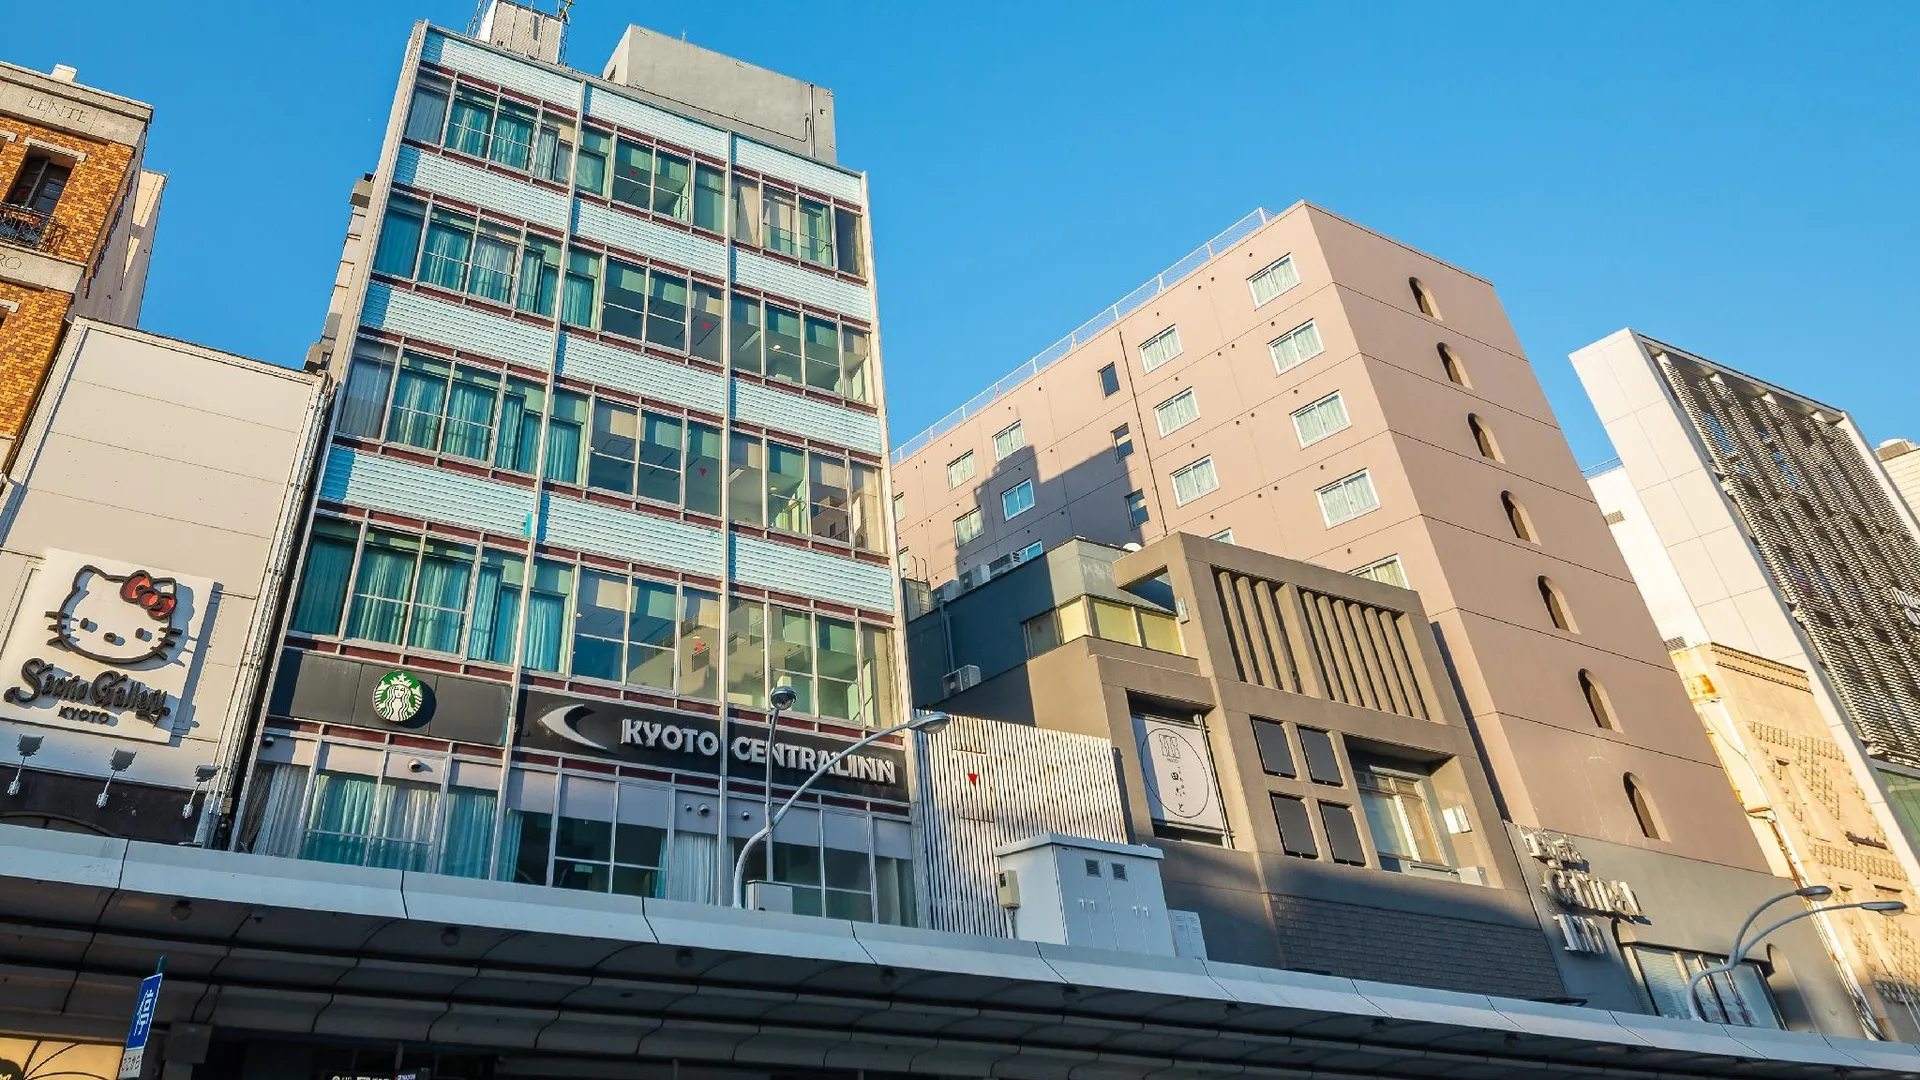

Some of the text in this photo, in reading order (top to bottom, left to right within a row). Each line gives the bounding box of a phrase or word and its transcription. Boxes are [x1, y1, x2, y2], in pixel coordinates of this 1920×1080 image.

[26, 95, 89, 124] LENTE
[57, 705, 110, 725] KYOTO
[621, 718, 896, 784] KYOTO CENTRAL INN
